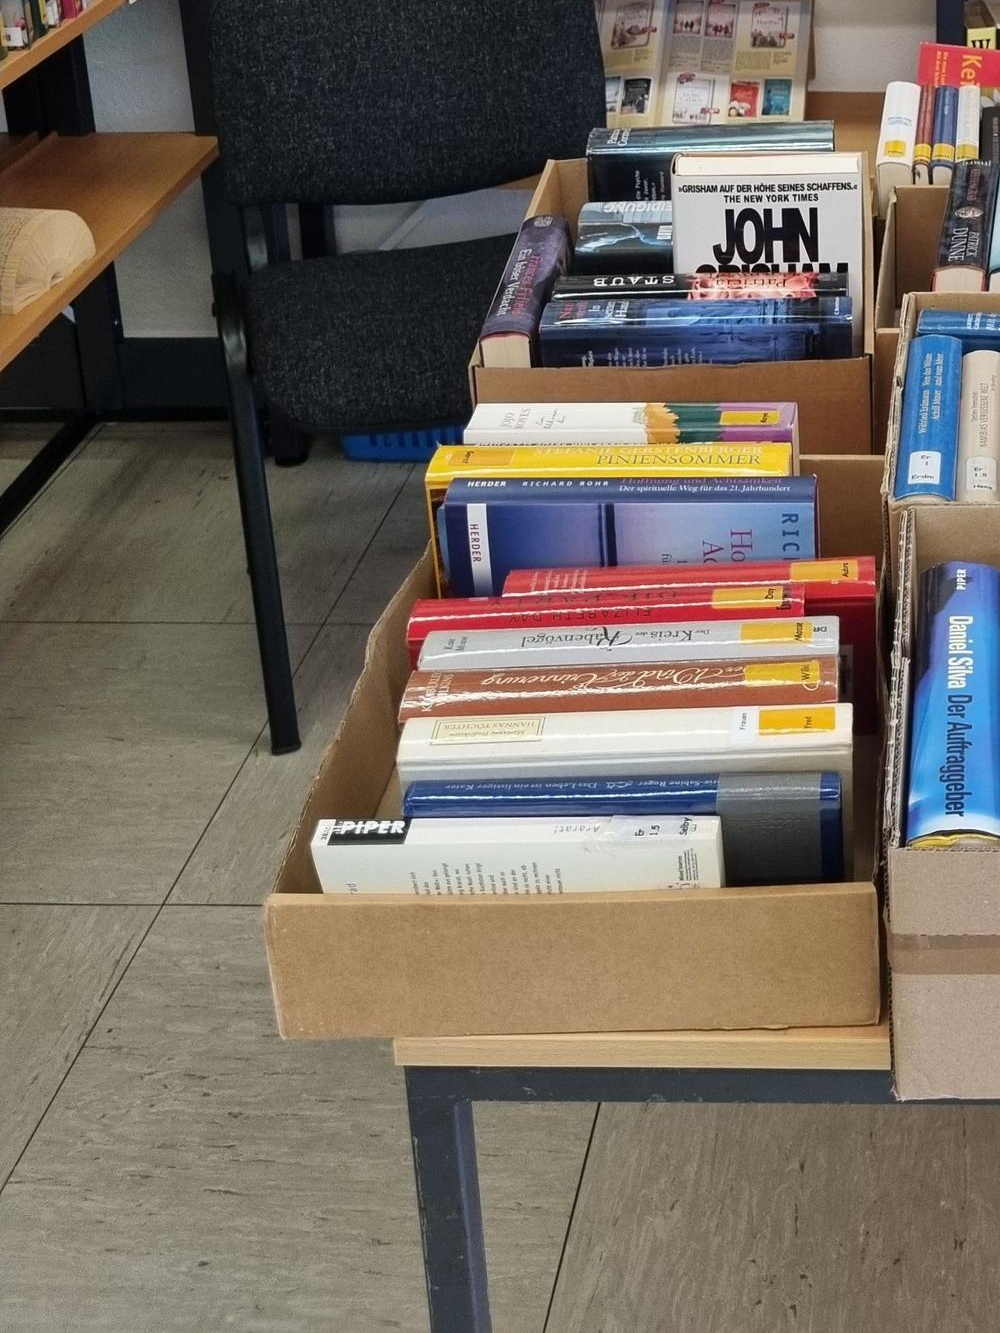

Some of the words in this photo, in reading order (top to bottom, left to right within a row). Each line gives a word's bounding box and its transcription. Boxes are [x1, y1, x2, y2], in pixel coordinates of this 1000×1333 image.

[720, 184, 735, 193] AUF
[737, 184, 754, 192] DER
[756, 182, 776, 192] HÖHE
[777, 183, 805, 192] SEINES
[724, 195, 740, 203] THE
[743, 195, 760, 203] NEW
[791, 194, 818, 202] TIMES
[713, 208, 818, 263] JOHN
[949, 227, 968, 261] DUNNE
[593, 276, 674, 286] STAUB
[596, 453, 761, 466] PINIENSOMMER
[636, 485, 676, 493] spirituelle
[678, 485, 698, 493] Weg
[700, 484, 711, 492] für
[470, 524, 481, 562] HERDER
[957, 569, 966, 590] PIPER
[949, 616, 973, 654] Daniel
[948, 657, 973, 689] Silva
[948, 695, 972, 716] Der
[940, 720, 972, 816] Auftraggeber
[341, 821, 404, 835] PIPER
